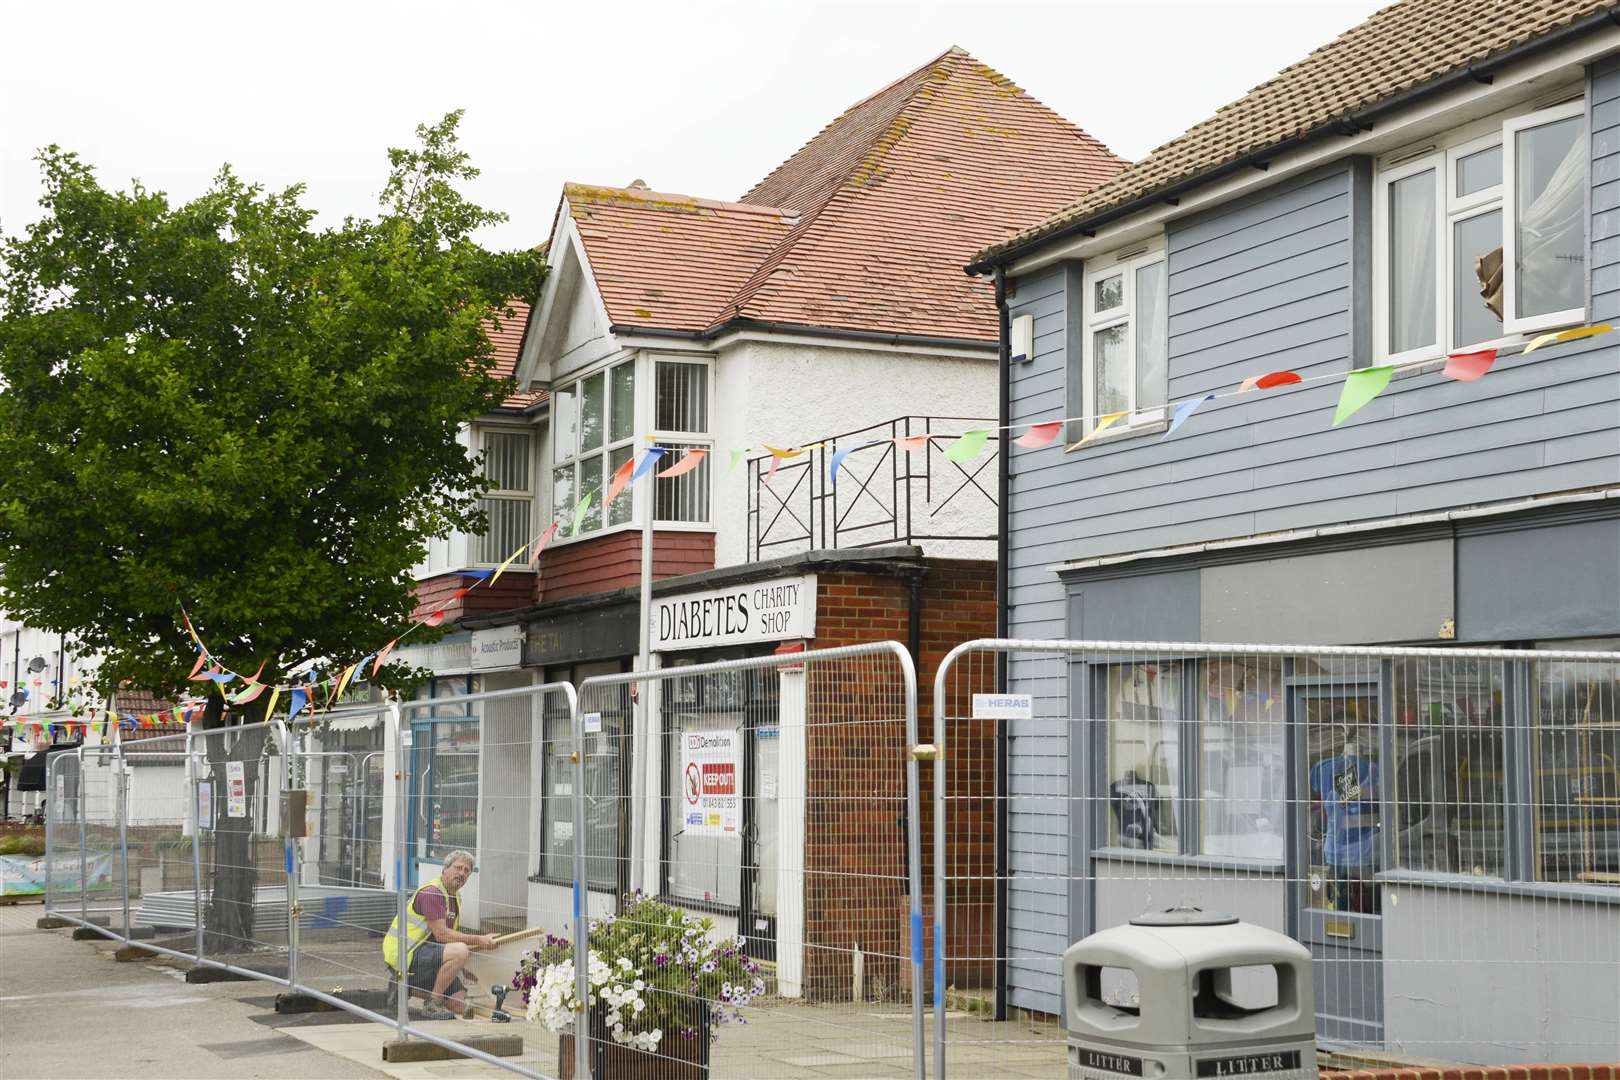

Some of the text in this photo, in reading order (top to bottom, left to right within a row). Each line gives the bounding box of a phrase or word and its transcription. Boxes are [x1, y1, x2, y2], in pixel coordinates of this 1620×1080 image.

[753, 584, 800, 611] CHARITY
[660, 593, 749, 641] DIABETES
[761, 611, 791, 634] SHOP
[988, 698, 1029, 708] HERAS
[703, 773, 719, 786] KEEP
[1089, 1053, 1131, 1073] LITTER
[1216, 1056, 1284, 1075] LITTER
